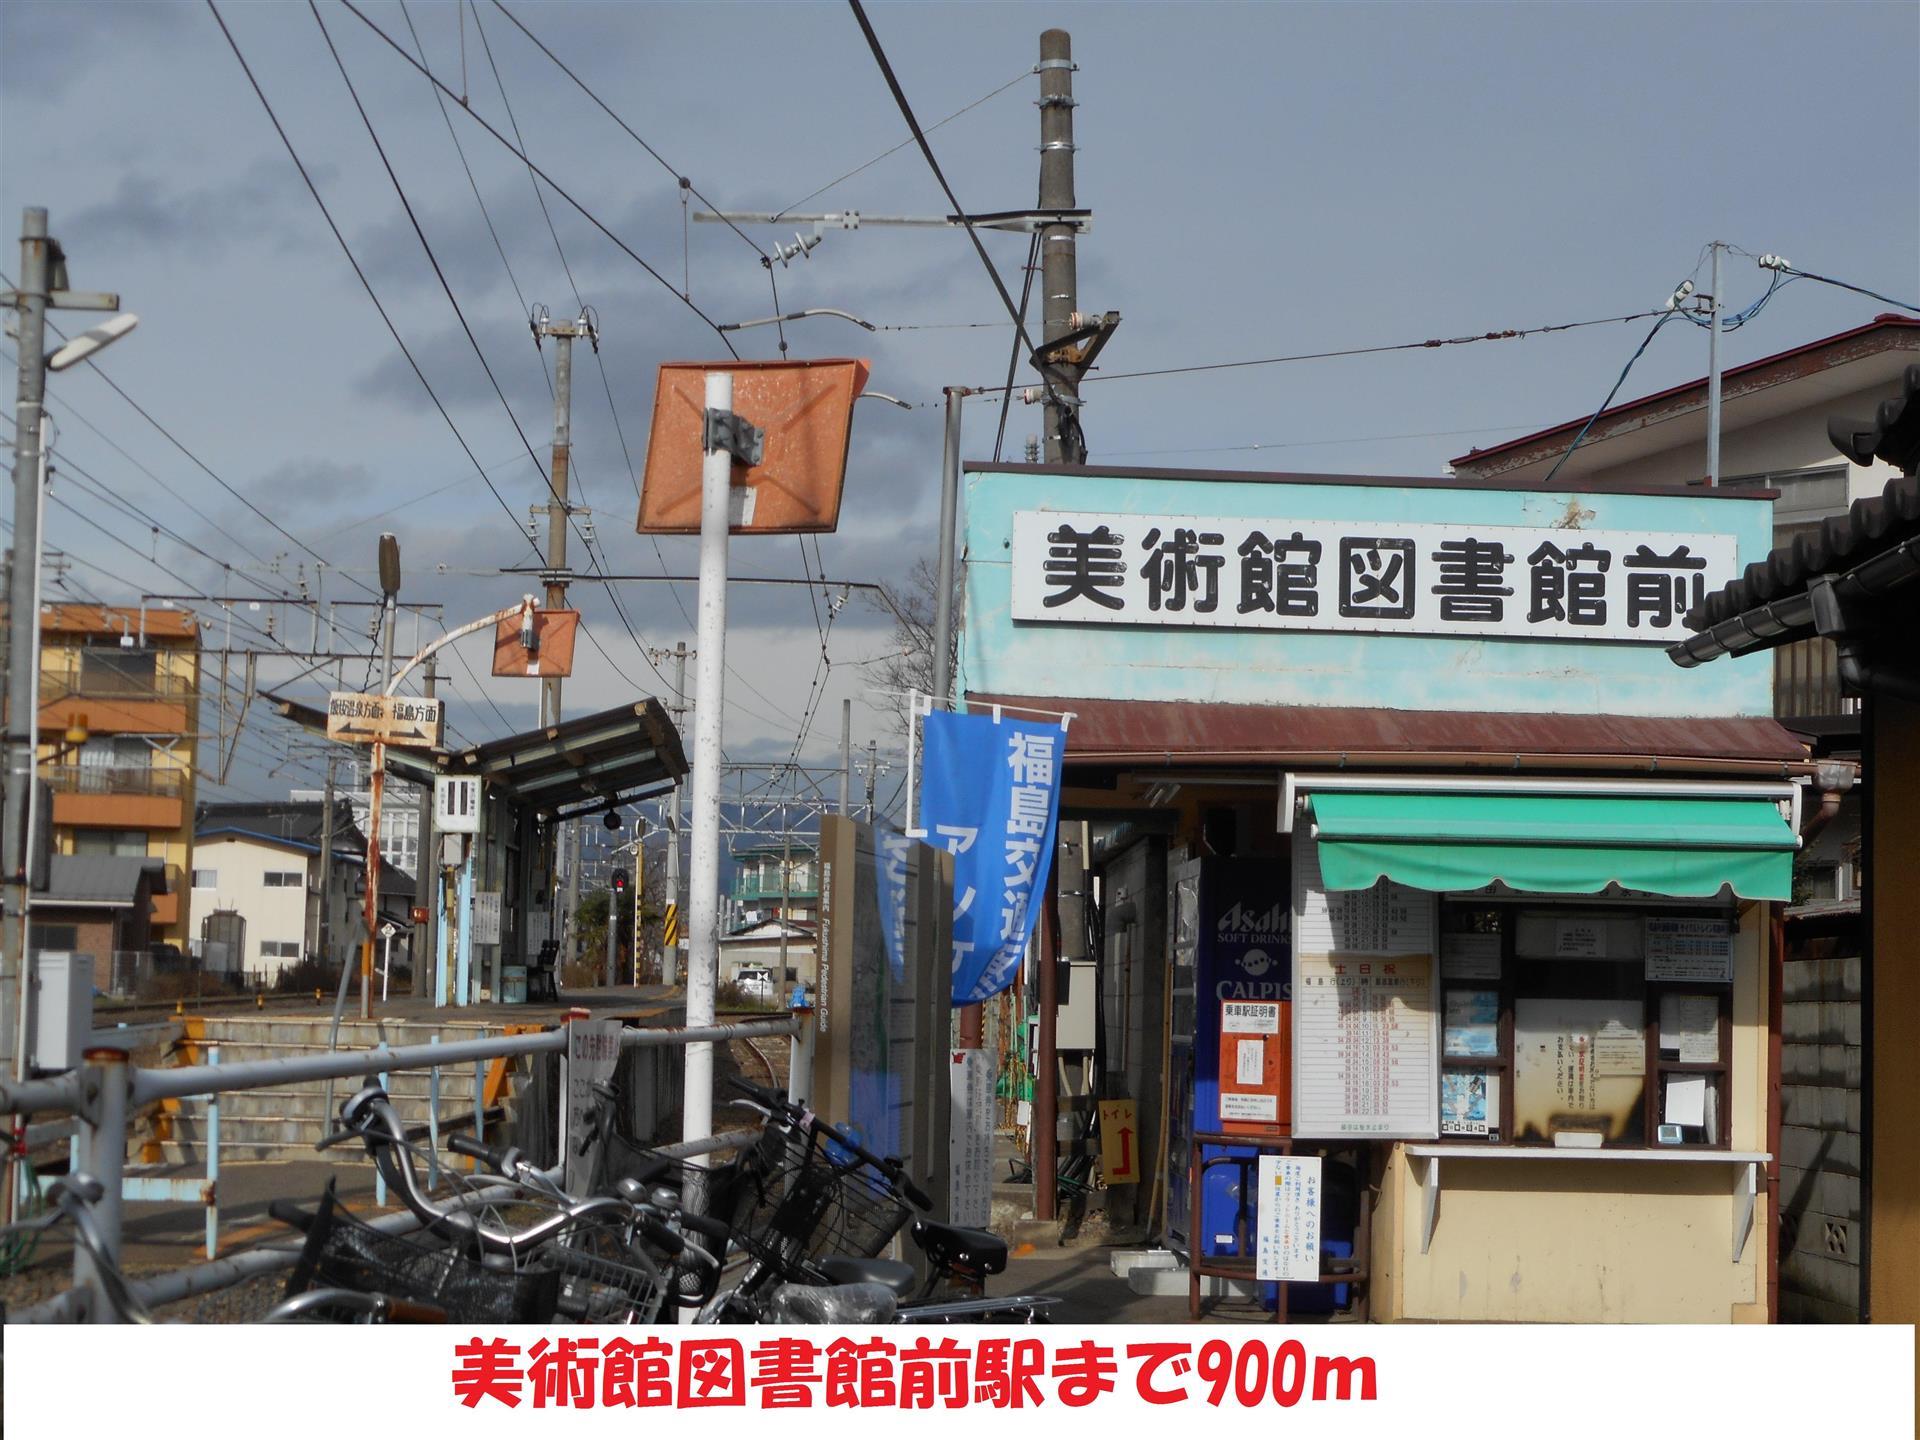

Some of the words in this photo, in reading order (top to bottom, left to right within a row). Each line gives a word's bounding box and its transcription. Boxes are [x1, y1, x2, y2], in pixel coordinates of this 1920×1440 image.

[1043, 524, 1707, 629] 美術館図書館前
[393, 703, 437, 722] 福島方面
[821, 918, 831, 962] Fukushima
[1217, 932, 1247, 943] SOFT
[820, 963, 830, 1007] Pedestrian
[819, 1009, 829, 1033] Guide
[1225, 1005, 1276, 1018] 乗車駅証明書
[1102, 1107, 1133, 1120] トイレ
[1305, 1176, 1317, 1262] お客様へのお願い
